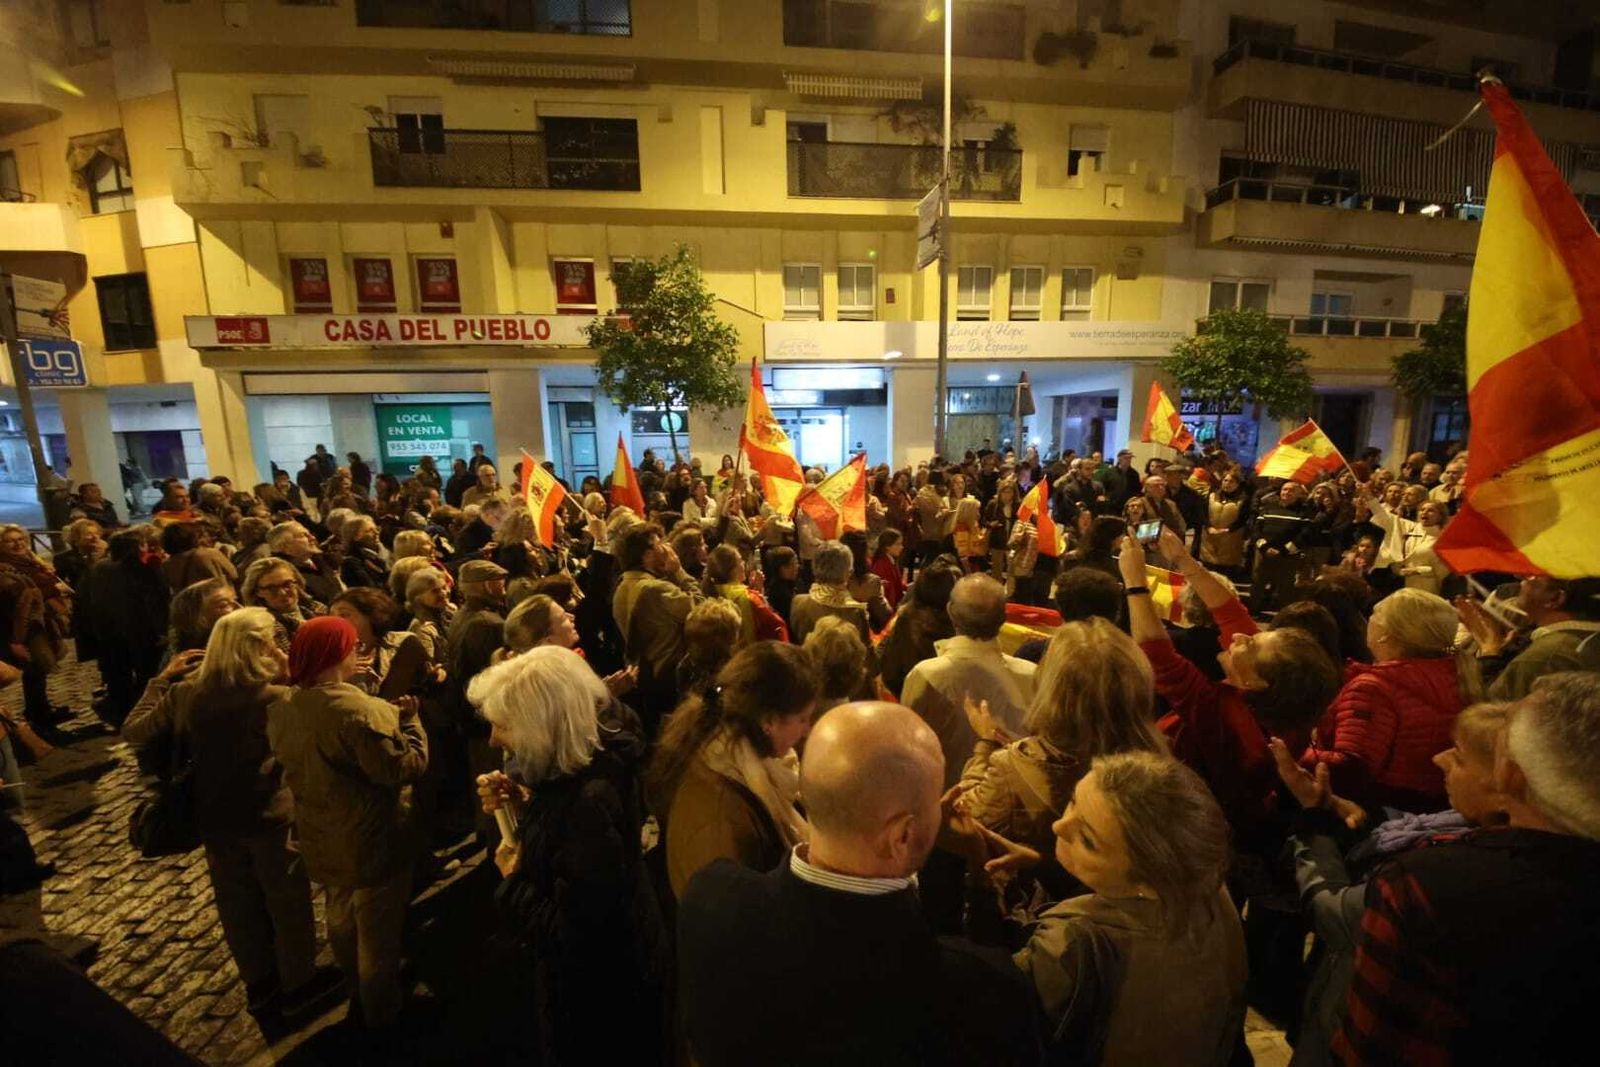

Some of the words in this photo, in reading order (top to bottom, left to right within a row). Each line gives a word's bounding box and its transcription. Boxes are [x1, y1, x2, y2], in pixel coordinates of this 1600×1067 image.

[219, 330, 242, 339] PSOE
[324, 319, 392, 341] CASA
[400, 319, 447, 340] DEL
[454, 319, 551, 340] PUEBLO
[396, 414, 433, 423] LOCAL
[388, 426, 404, 436] EN
[408, 426, 445, 436] VENTA
